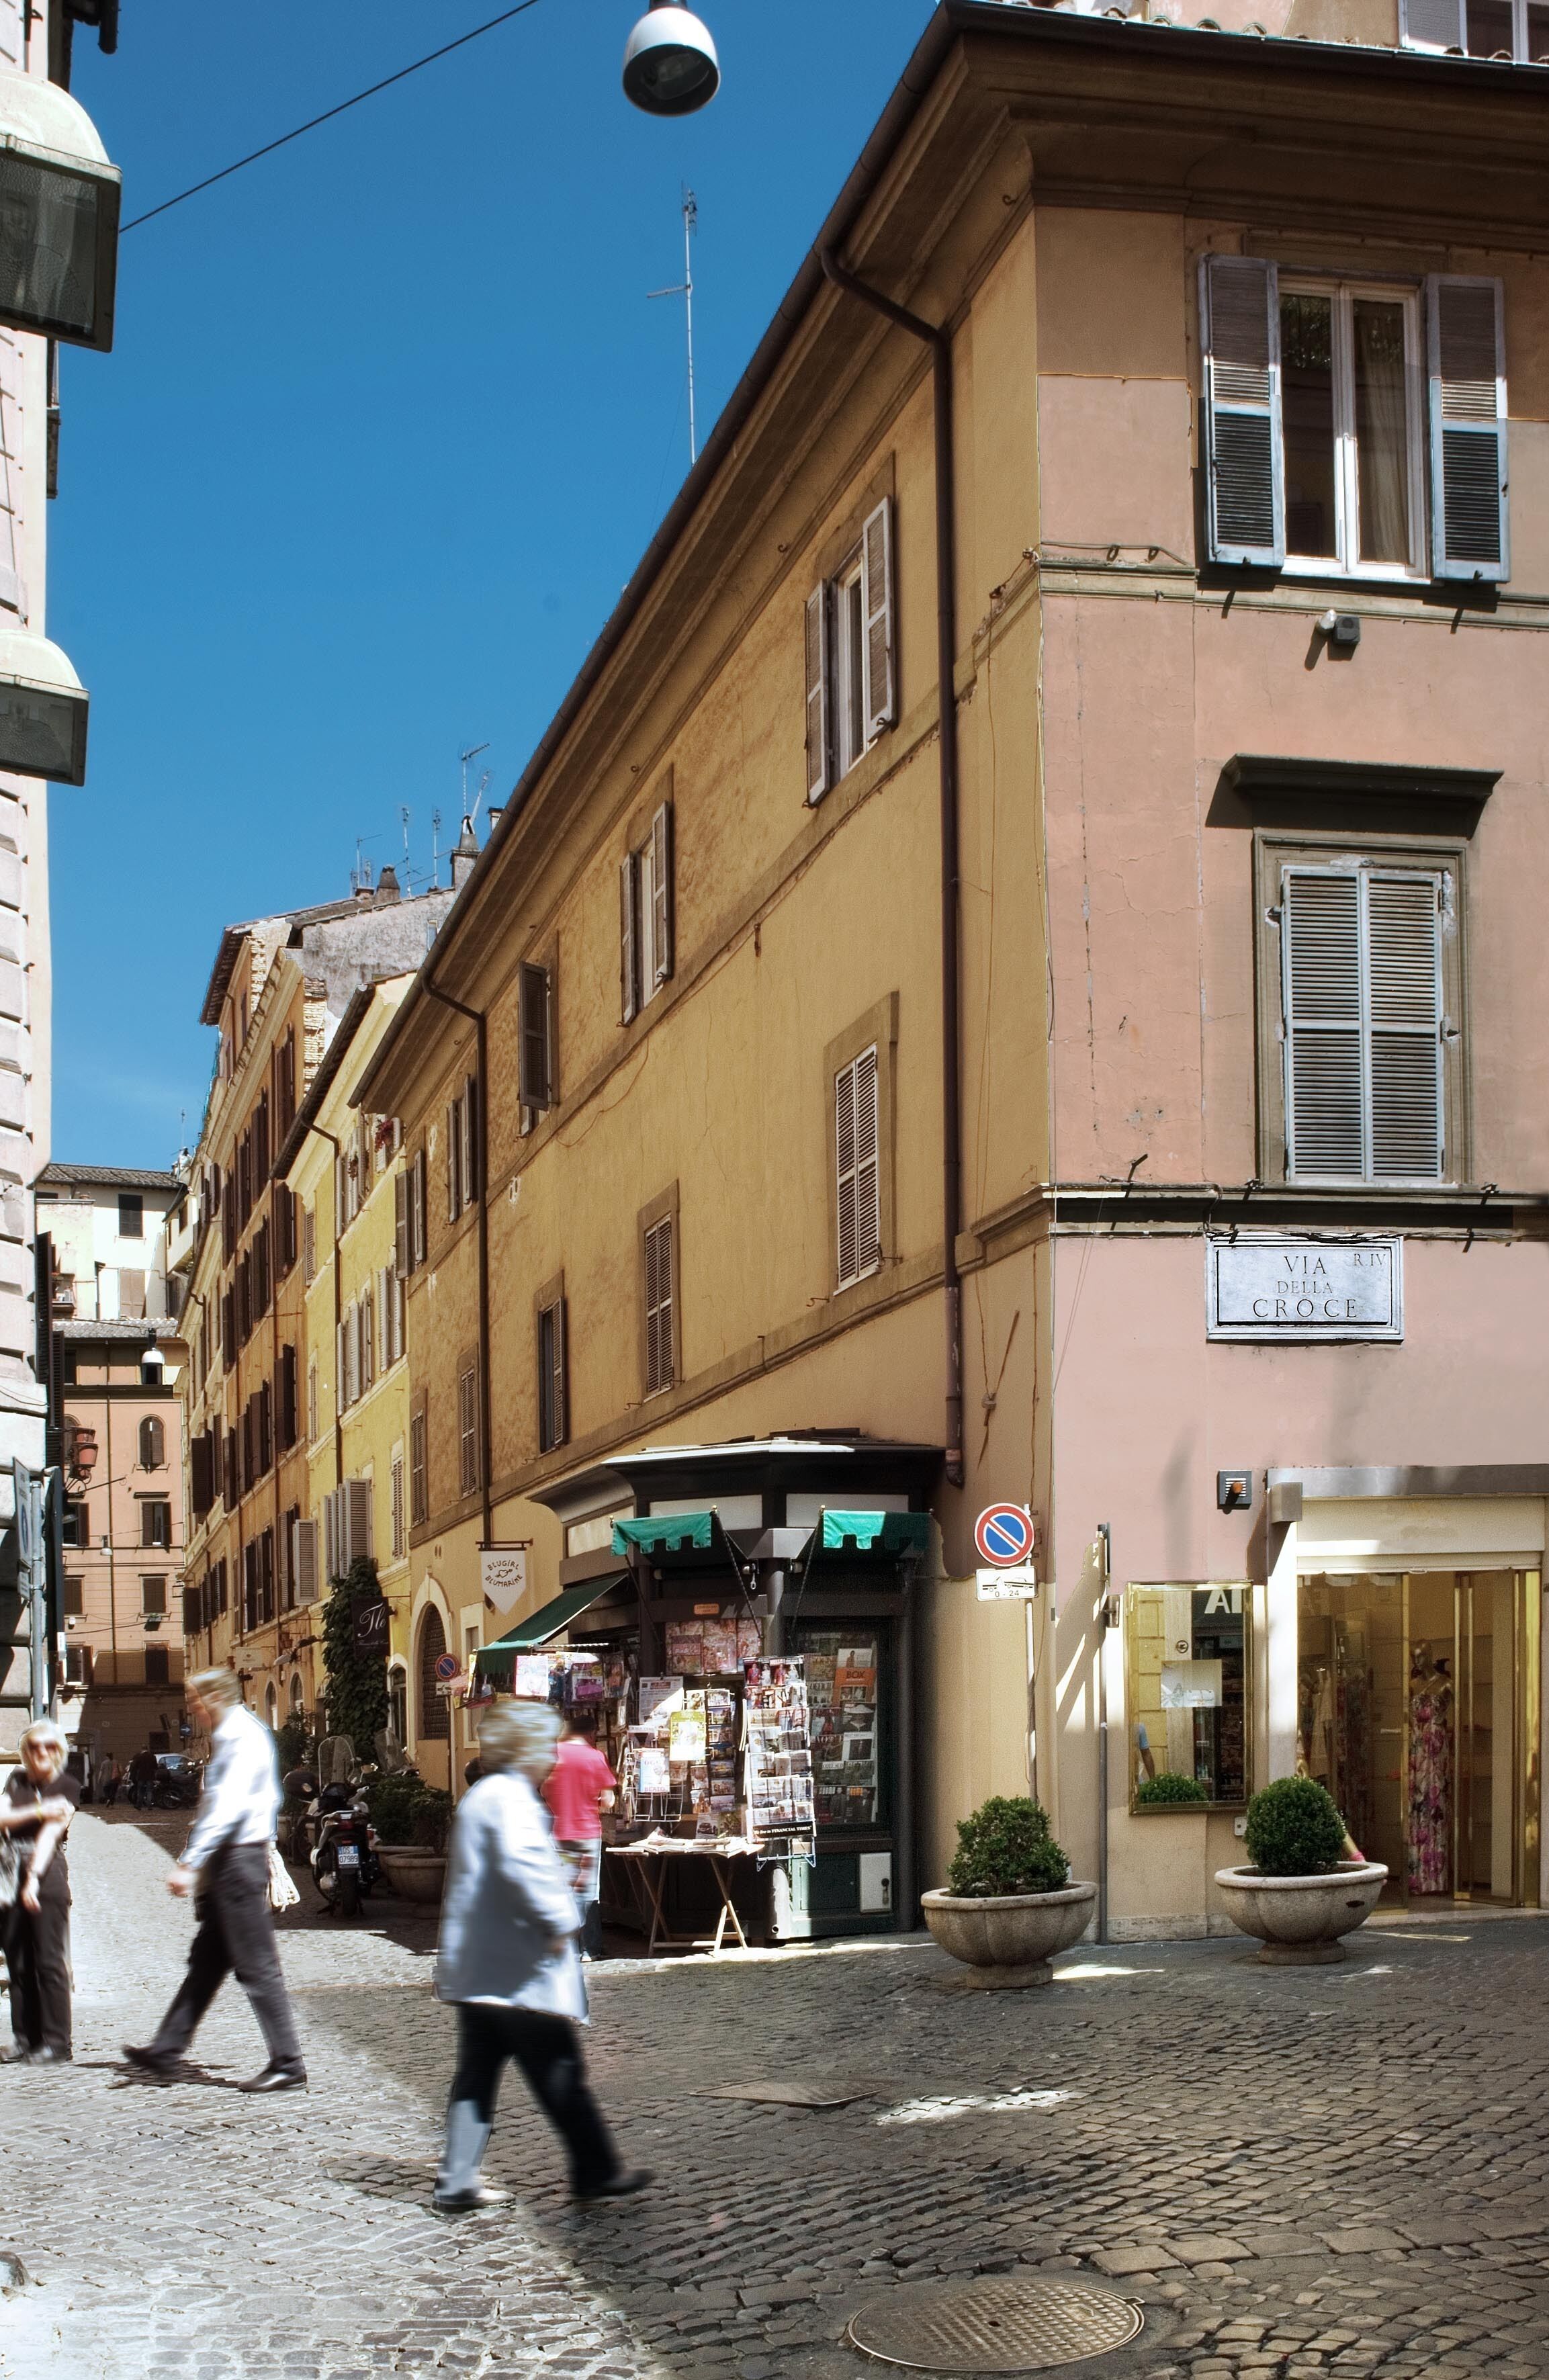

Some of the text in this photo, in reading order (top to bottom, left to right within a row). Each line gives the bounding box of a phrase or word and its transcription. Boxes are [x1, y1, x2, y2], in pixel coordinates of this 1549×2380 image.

[1284, 1255, 1327, 1274] VIA
[1277, 1280, 1333, 1294] DELLA
[1253, 1298, 1357, 1318] CROCE
[487, 1560, 519, 1571] BLUGIRL
[485, 1574, 523, 1587] BLUMARINE
[846, 1671, 866, 1679] BOX
